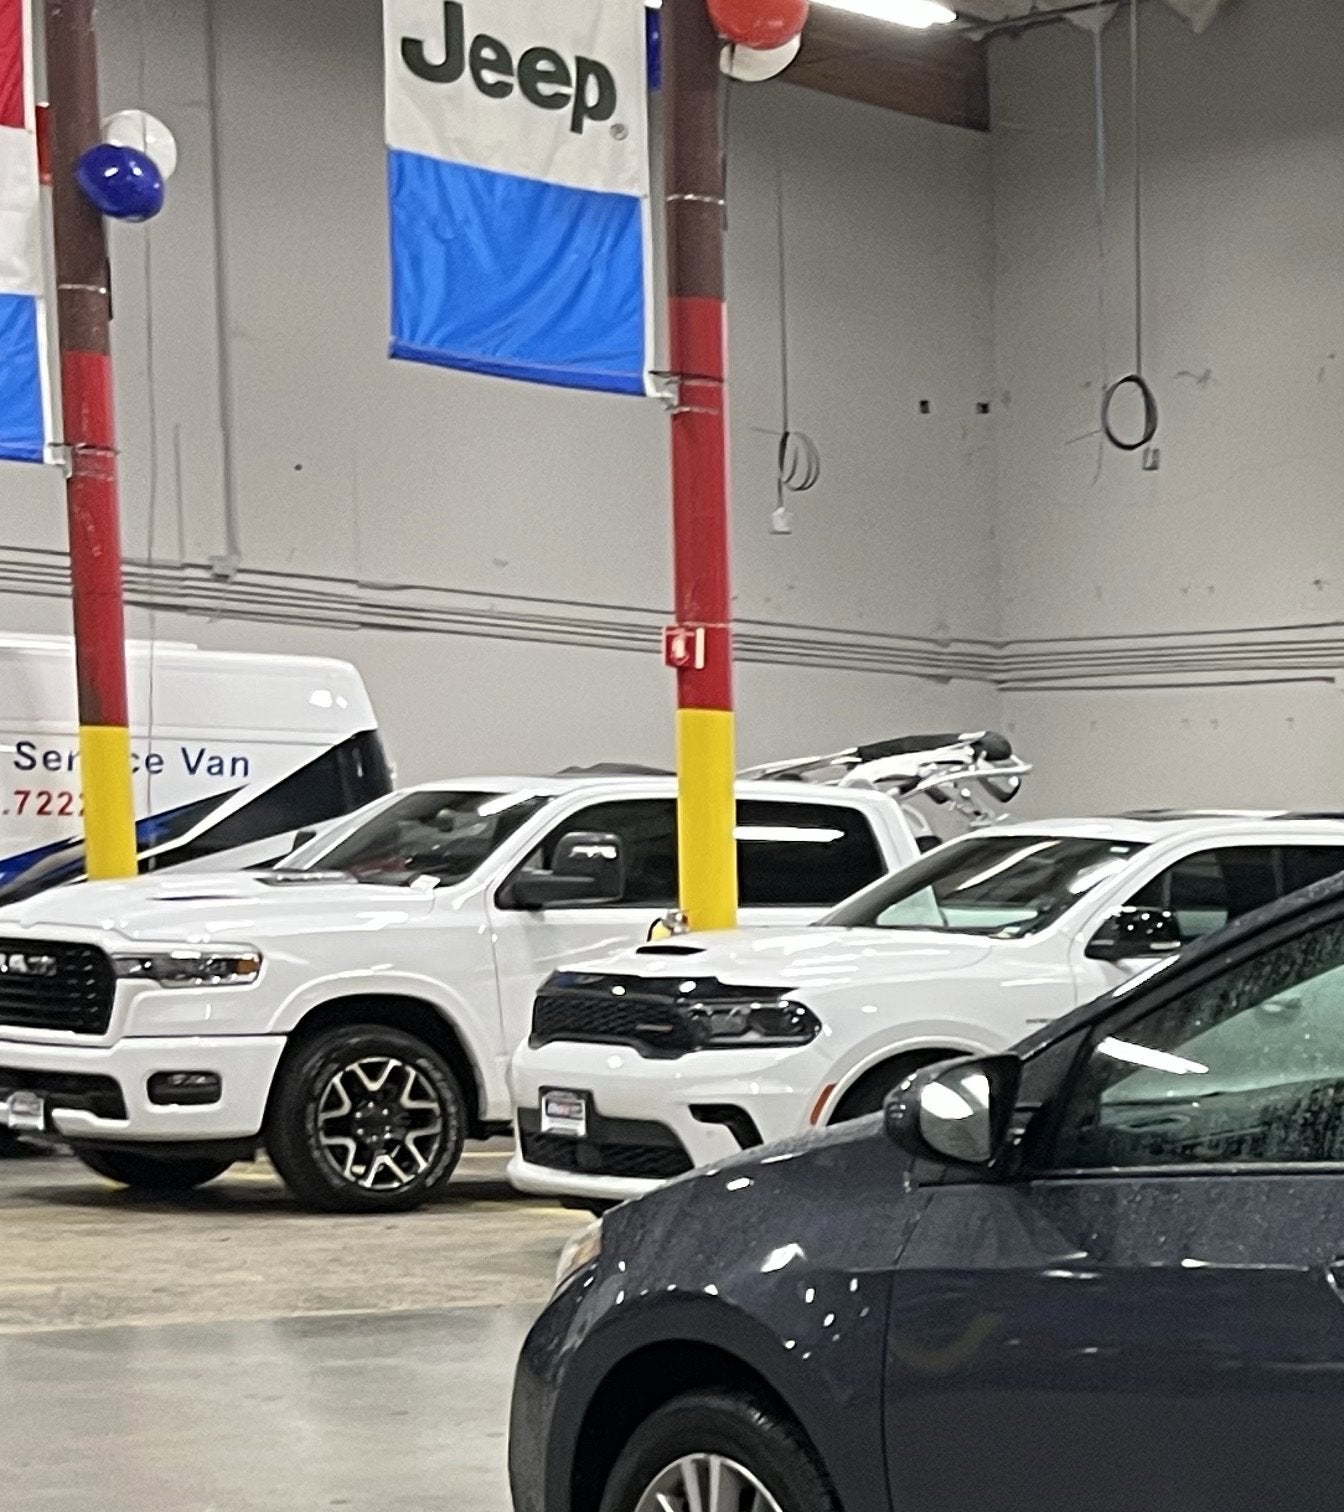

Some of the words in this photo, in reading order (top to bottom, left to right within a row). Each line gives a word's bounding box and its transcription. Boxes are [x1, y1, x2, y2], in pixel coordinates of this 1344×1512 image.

[400, 0, 617, 134] Jeep
[14, 741, 164, 774] Sere
[181, 746, 249, 777] Van
